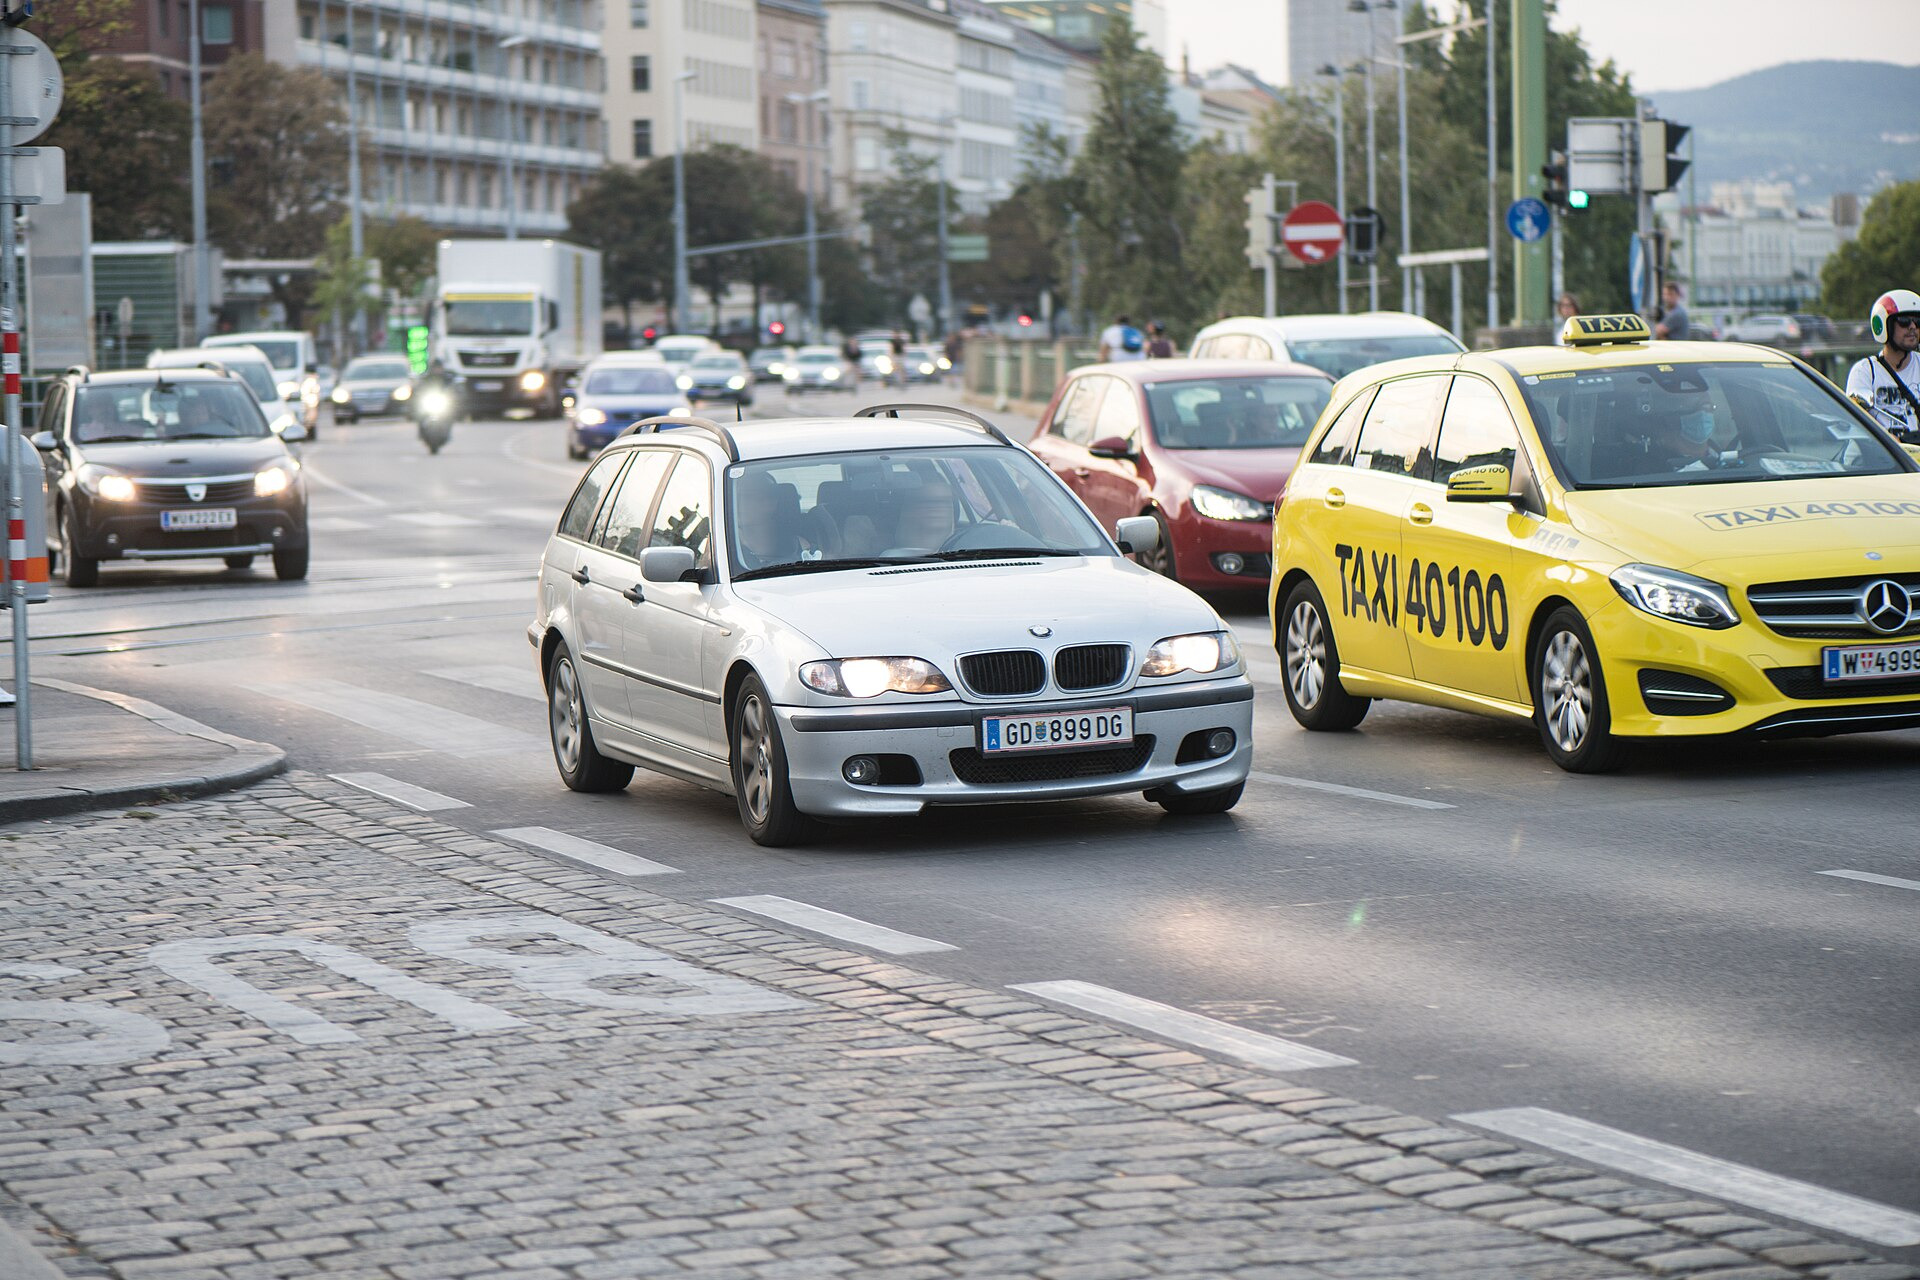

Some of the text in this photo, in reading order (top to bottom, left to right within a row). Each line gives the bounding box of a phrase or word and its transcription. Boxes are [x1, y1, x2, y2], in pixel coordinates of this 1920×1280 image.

[1579, 316, 1641, 332] TAXI
[1704, 502, 1920, 527] TAXI 40100
[1335, 543, 1509, 652] TAXI 40100
[1843, 653, 1859, 674] W
[1006, 714, 1122, 746] GD 899 DG
